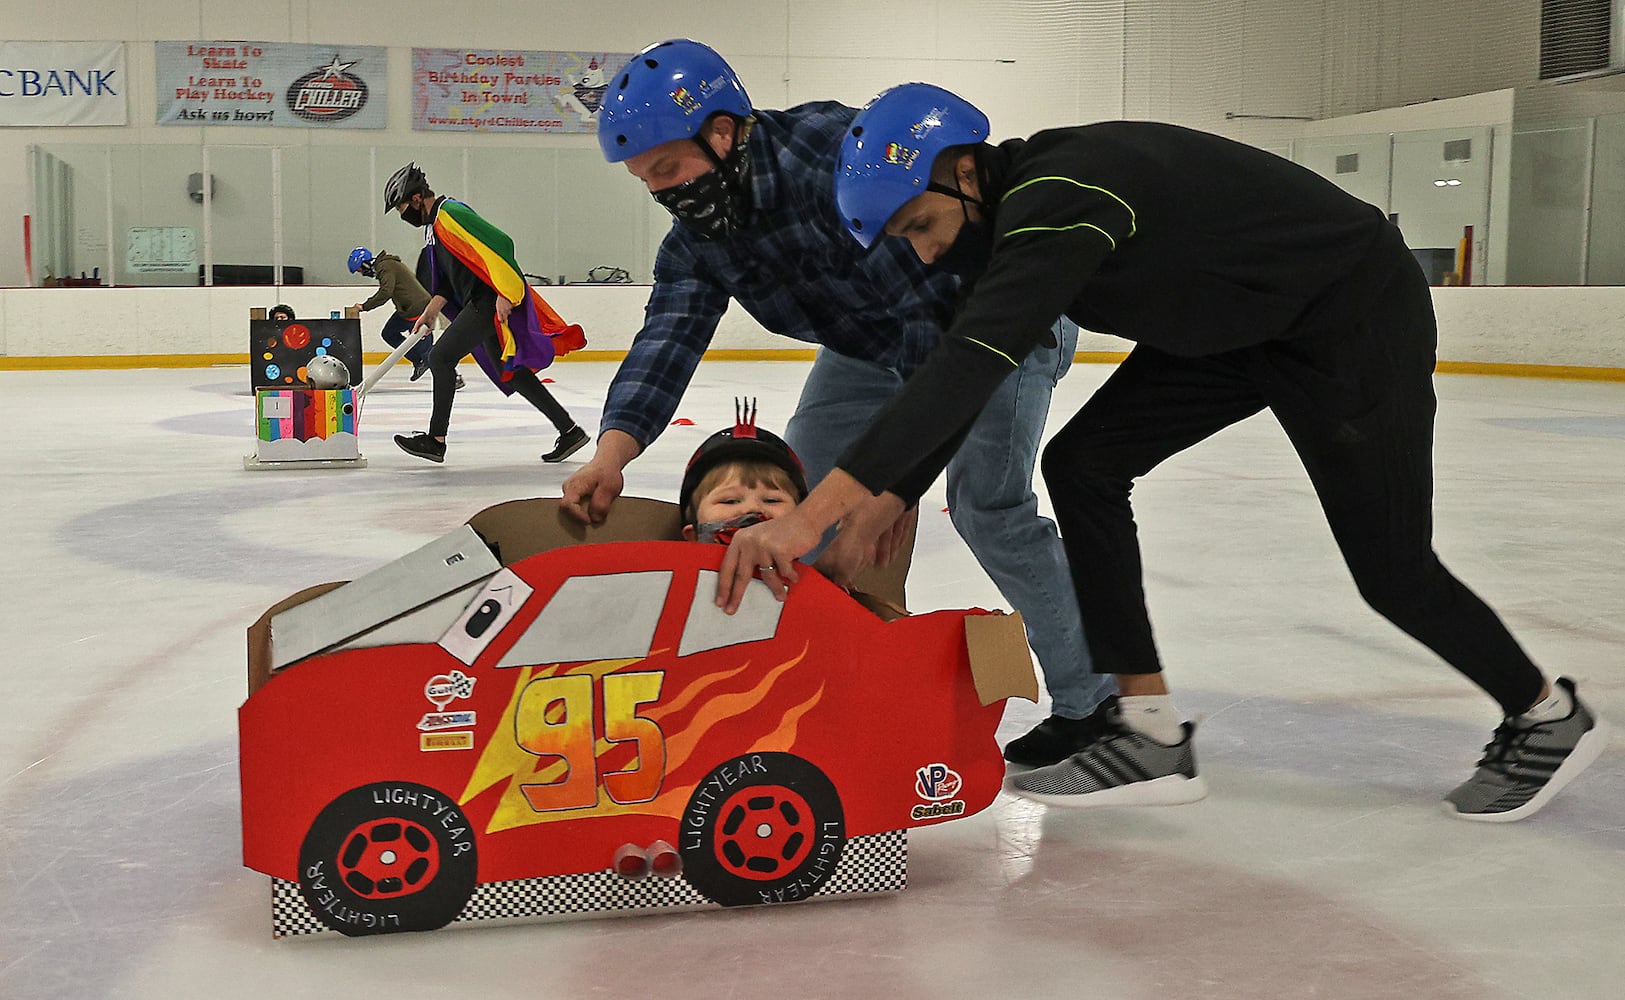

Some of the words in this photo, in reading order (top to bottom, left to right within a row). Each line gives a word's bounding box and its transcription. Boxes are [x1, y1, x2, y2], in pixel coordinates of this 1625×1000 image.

[187, 45, 236, 56] Learn
[241, 46, 263, 57] To
[203, 58, 248, 69] Skate
[465, 53, 525, 67] Coolest
[189, 76, 236, 87] Learn
[241, 76, 262, 88] To
[428, 71, 499, 86] Birthday
[504, 73, 561, 86] Parties
[176, 88, 210, 103] Play
[213, 89, 275, 104] Hockey
[294, 88, 363, 111] CHILLER
[461, 91, 478, 103] In
[482, 91, 529, 104] Town!
[177, 108, 207, 121] Ask
[212, 110, 230, 121] us
[233, 109, 275, 121] how!
[514, 669, 667, 812] 95
[918, 766, 946, 798] VP
[686, 755, 768, 850] LIGHTYEAR
[373, 788, 472, 857] LIGHTYEAR
[758, 822, 839, 905] LIGHTYEAR
[306, 860, 400, 927] LIGHTYEAR
